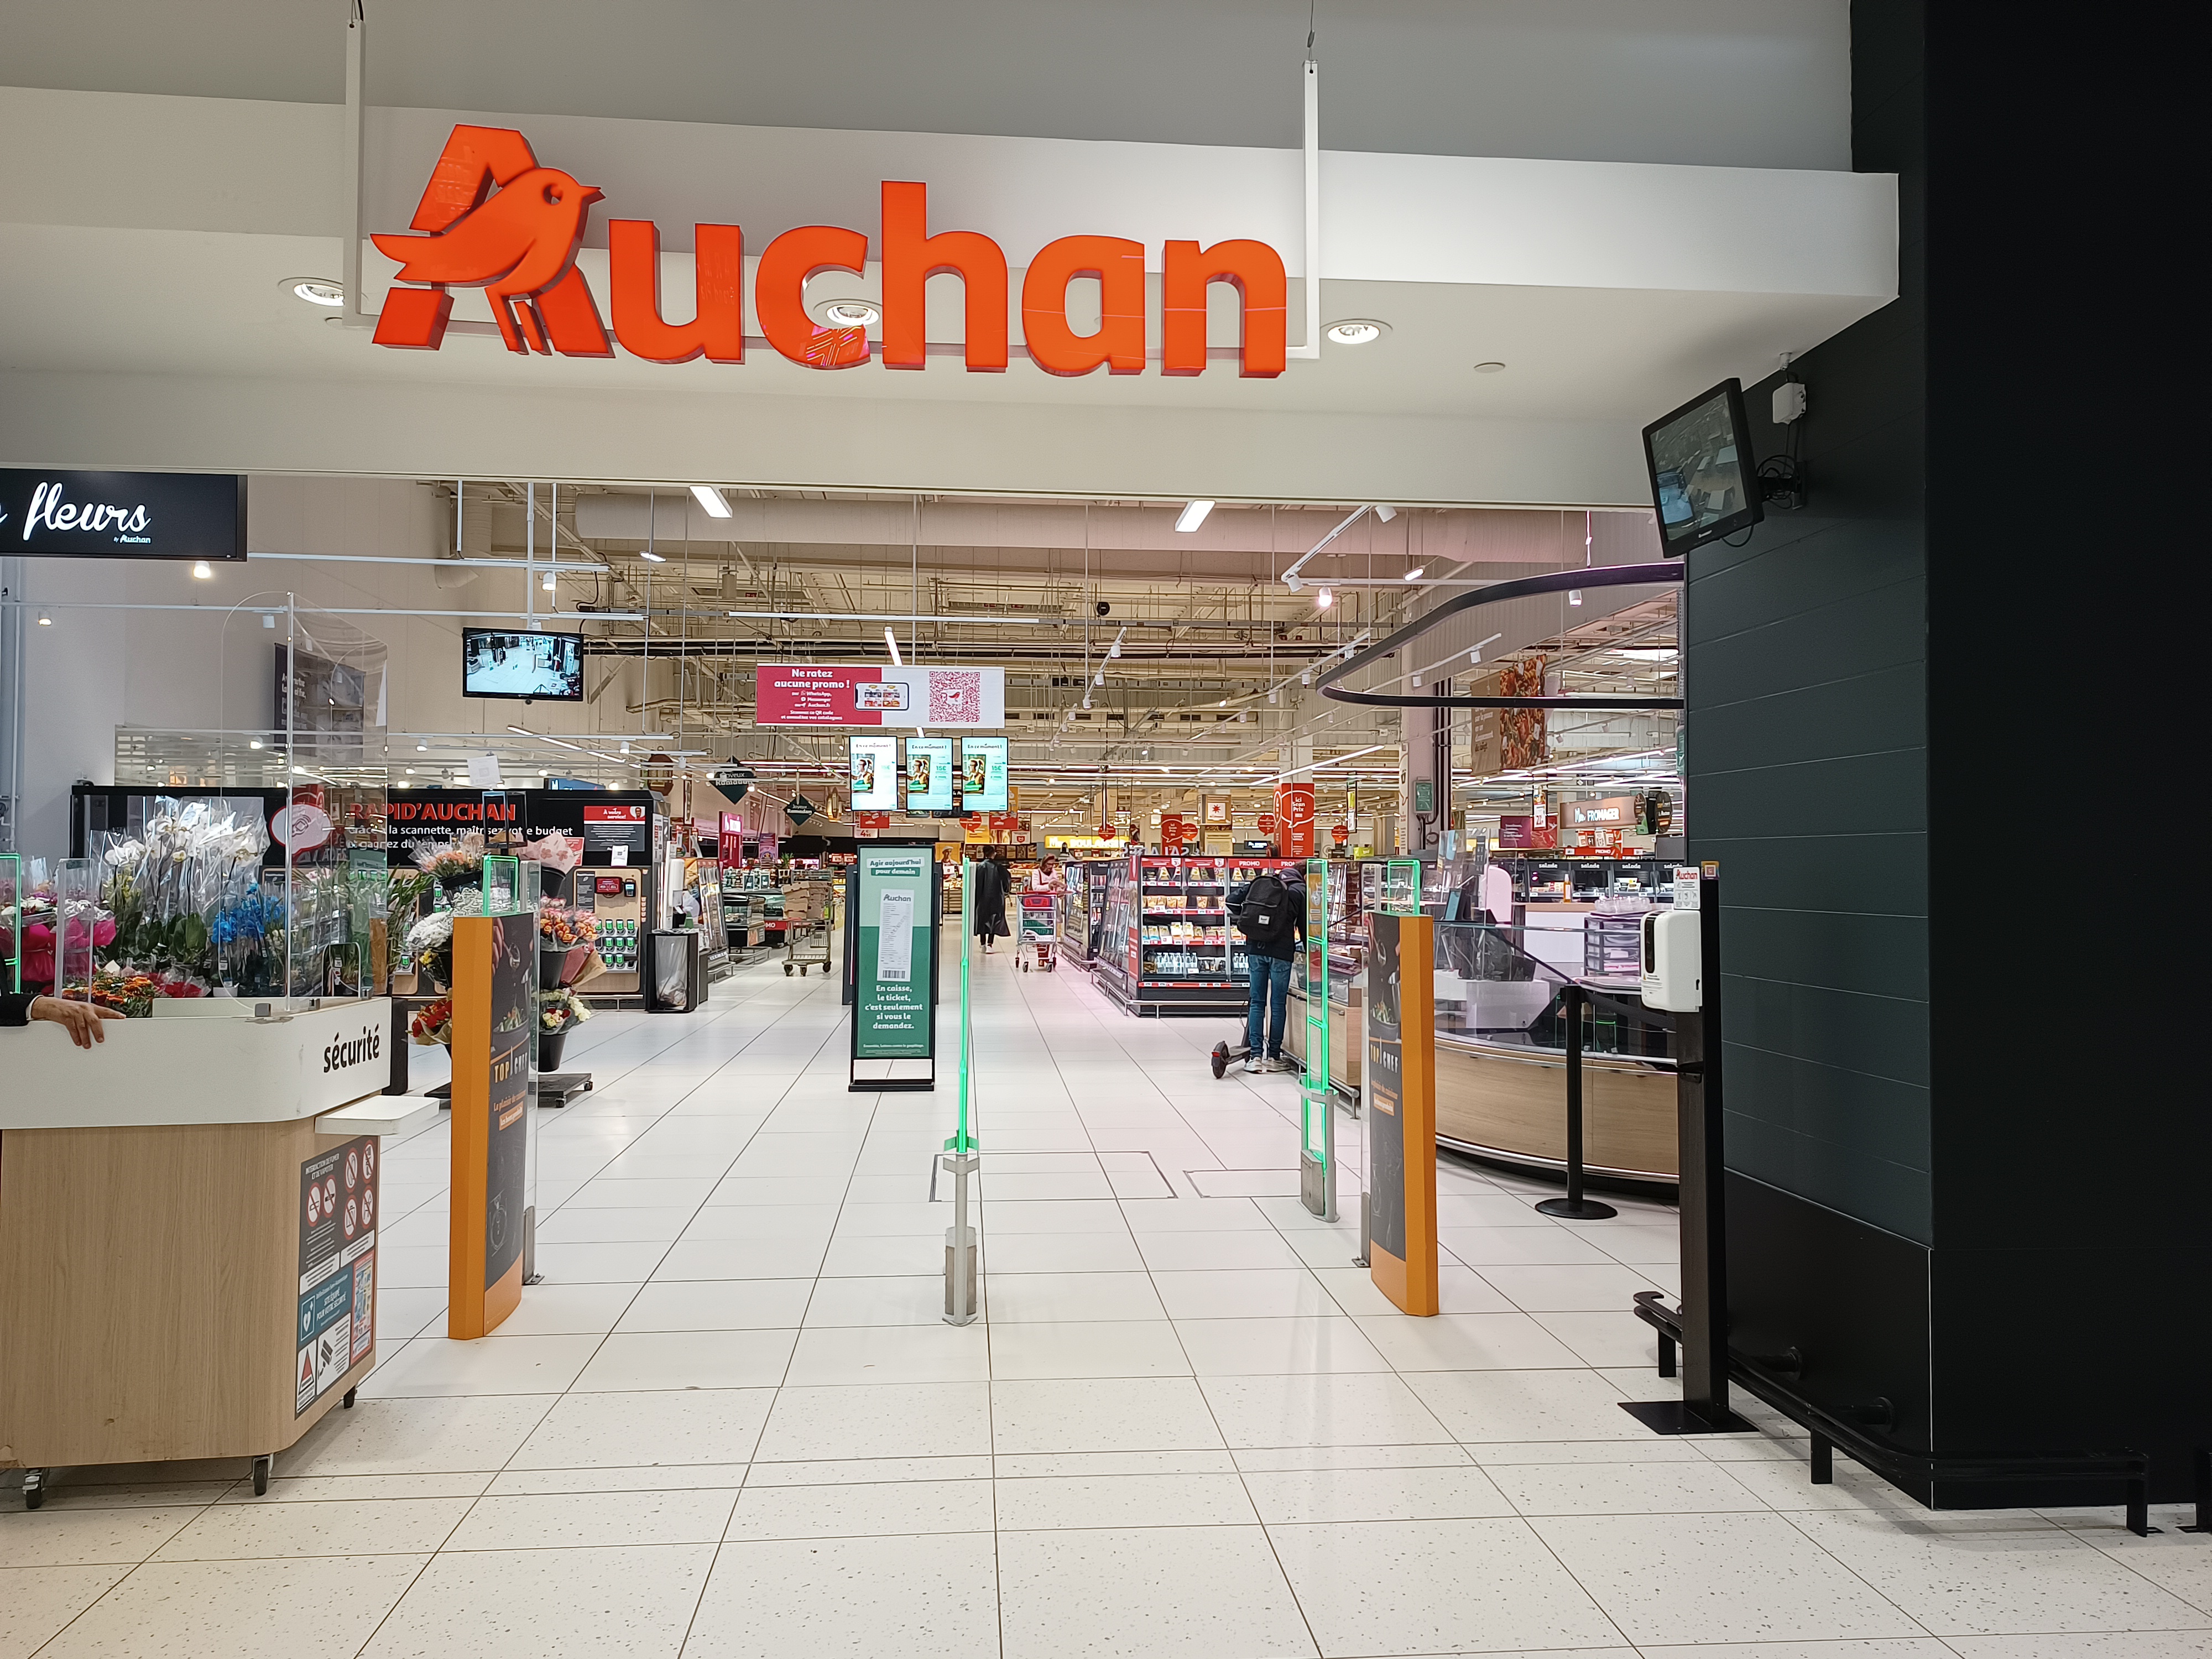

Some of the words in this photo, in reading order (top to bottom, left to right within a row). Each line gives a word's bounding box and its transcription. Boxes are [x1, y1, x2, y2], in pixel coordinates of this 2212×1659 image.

[370, 124, 1286, 378] Auchan
[23, 482, 152, 541] fleurs
[119, 534, 151, 544] Auchan
[791, 669, 806, 677] Ne
[806, 669, 833, 677] ratez
[812, 681, 844, 690] promo
[846, 680, 850, 688] !
[349, 803, 516, 821] RAPID'AUCHAN
[389, 825, 398, 834] la
[456, 825, 503, 835] maîtrsez
[508, 826, 533, 835] vote
[536, 825, 573, 837] budget
[401, 838, 414, 848] du
[885, 858, 921, 867] aujourd'hui
[1675, 869, 1698, 880] Auchan
[883, 894, 911, 902] Auchan
[886, 984, 912, 993] caisse,
[886, 994, 911, 1002] ticket,
[324, 1023, 379, 1073] sécurité
[1383, 1051, 1399, 1073] CHEF
[494, 1061, 509, 1083] TOP
[514, 1052, 528, 1074] CHEF
